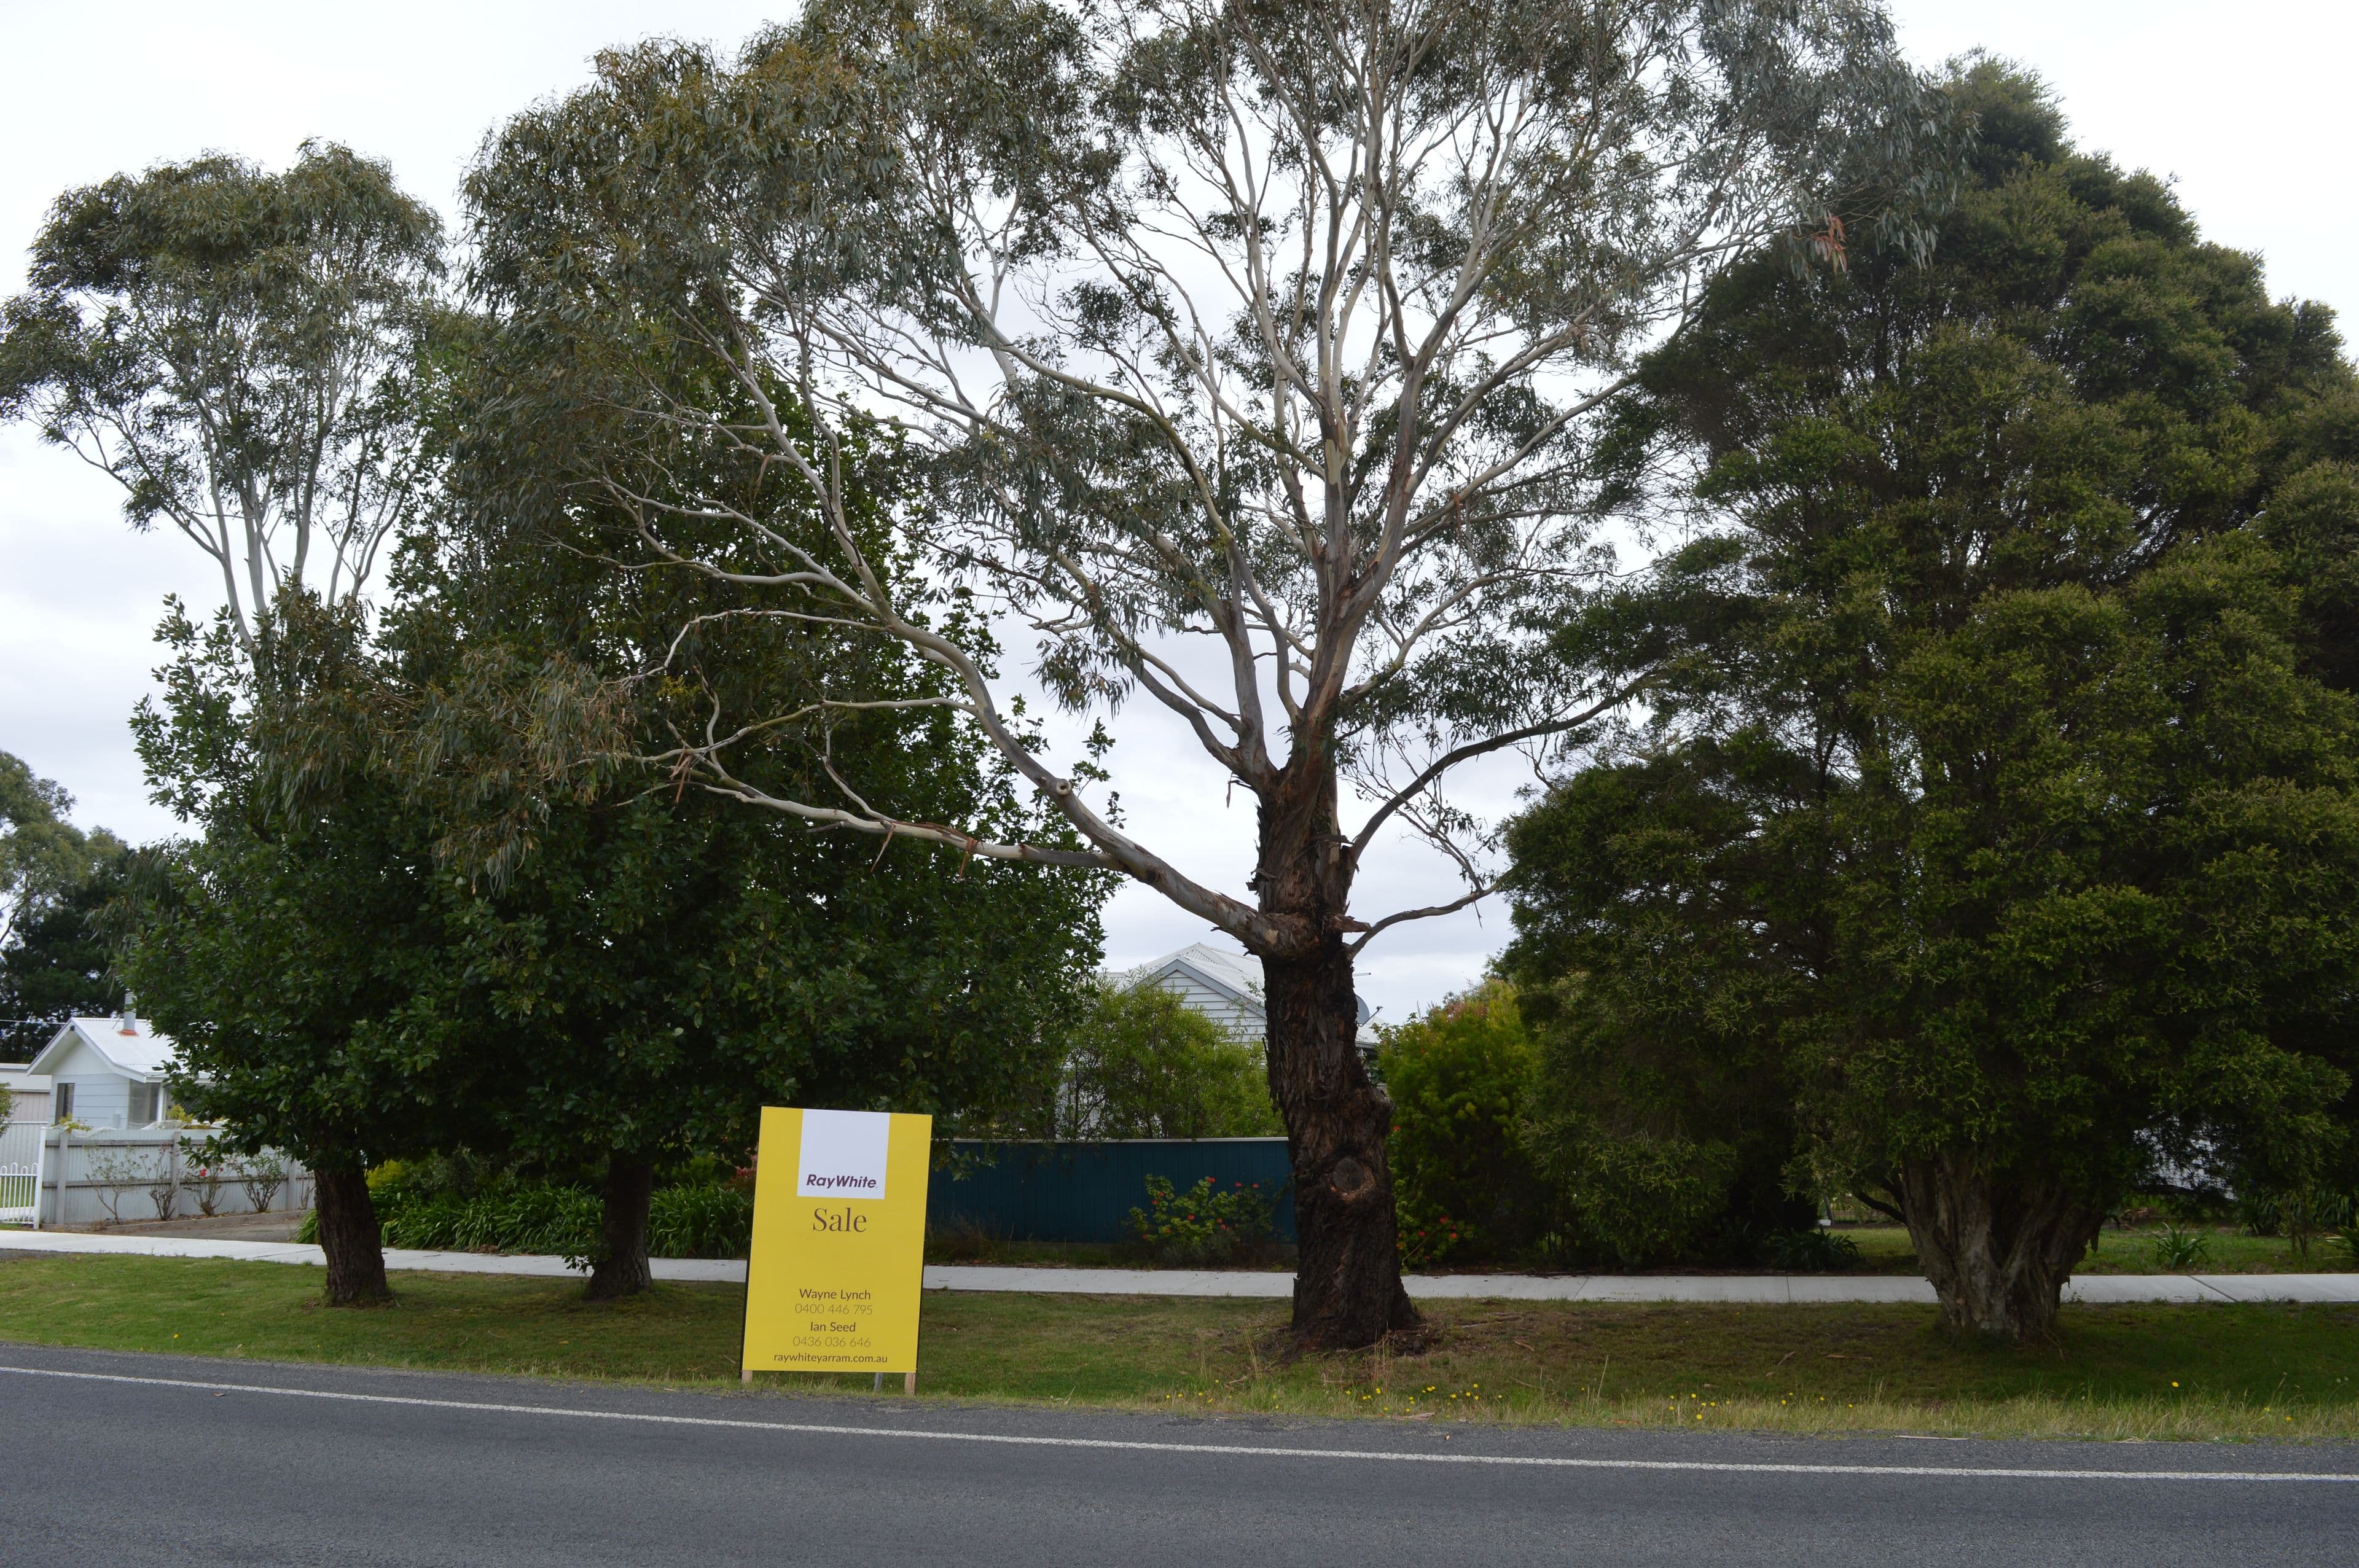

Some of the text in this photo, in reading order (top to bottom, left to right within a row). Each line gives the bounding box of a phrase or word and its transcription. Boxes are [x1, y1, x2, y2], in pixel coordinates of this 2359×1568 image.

[813, 1207, 867, 1233] Sale
[799, 1289, 871, 1301] Wayne Lynch
[795, 1303, 873, 1316] 0400 446 795
[810, 1322, 856, 1332] Ian Seed
[792, 1336, 871, 1348] 0436 036 646
[773, 1353, 888, 1363] raywhiteyarram.com.au
